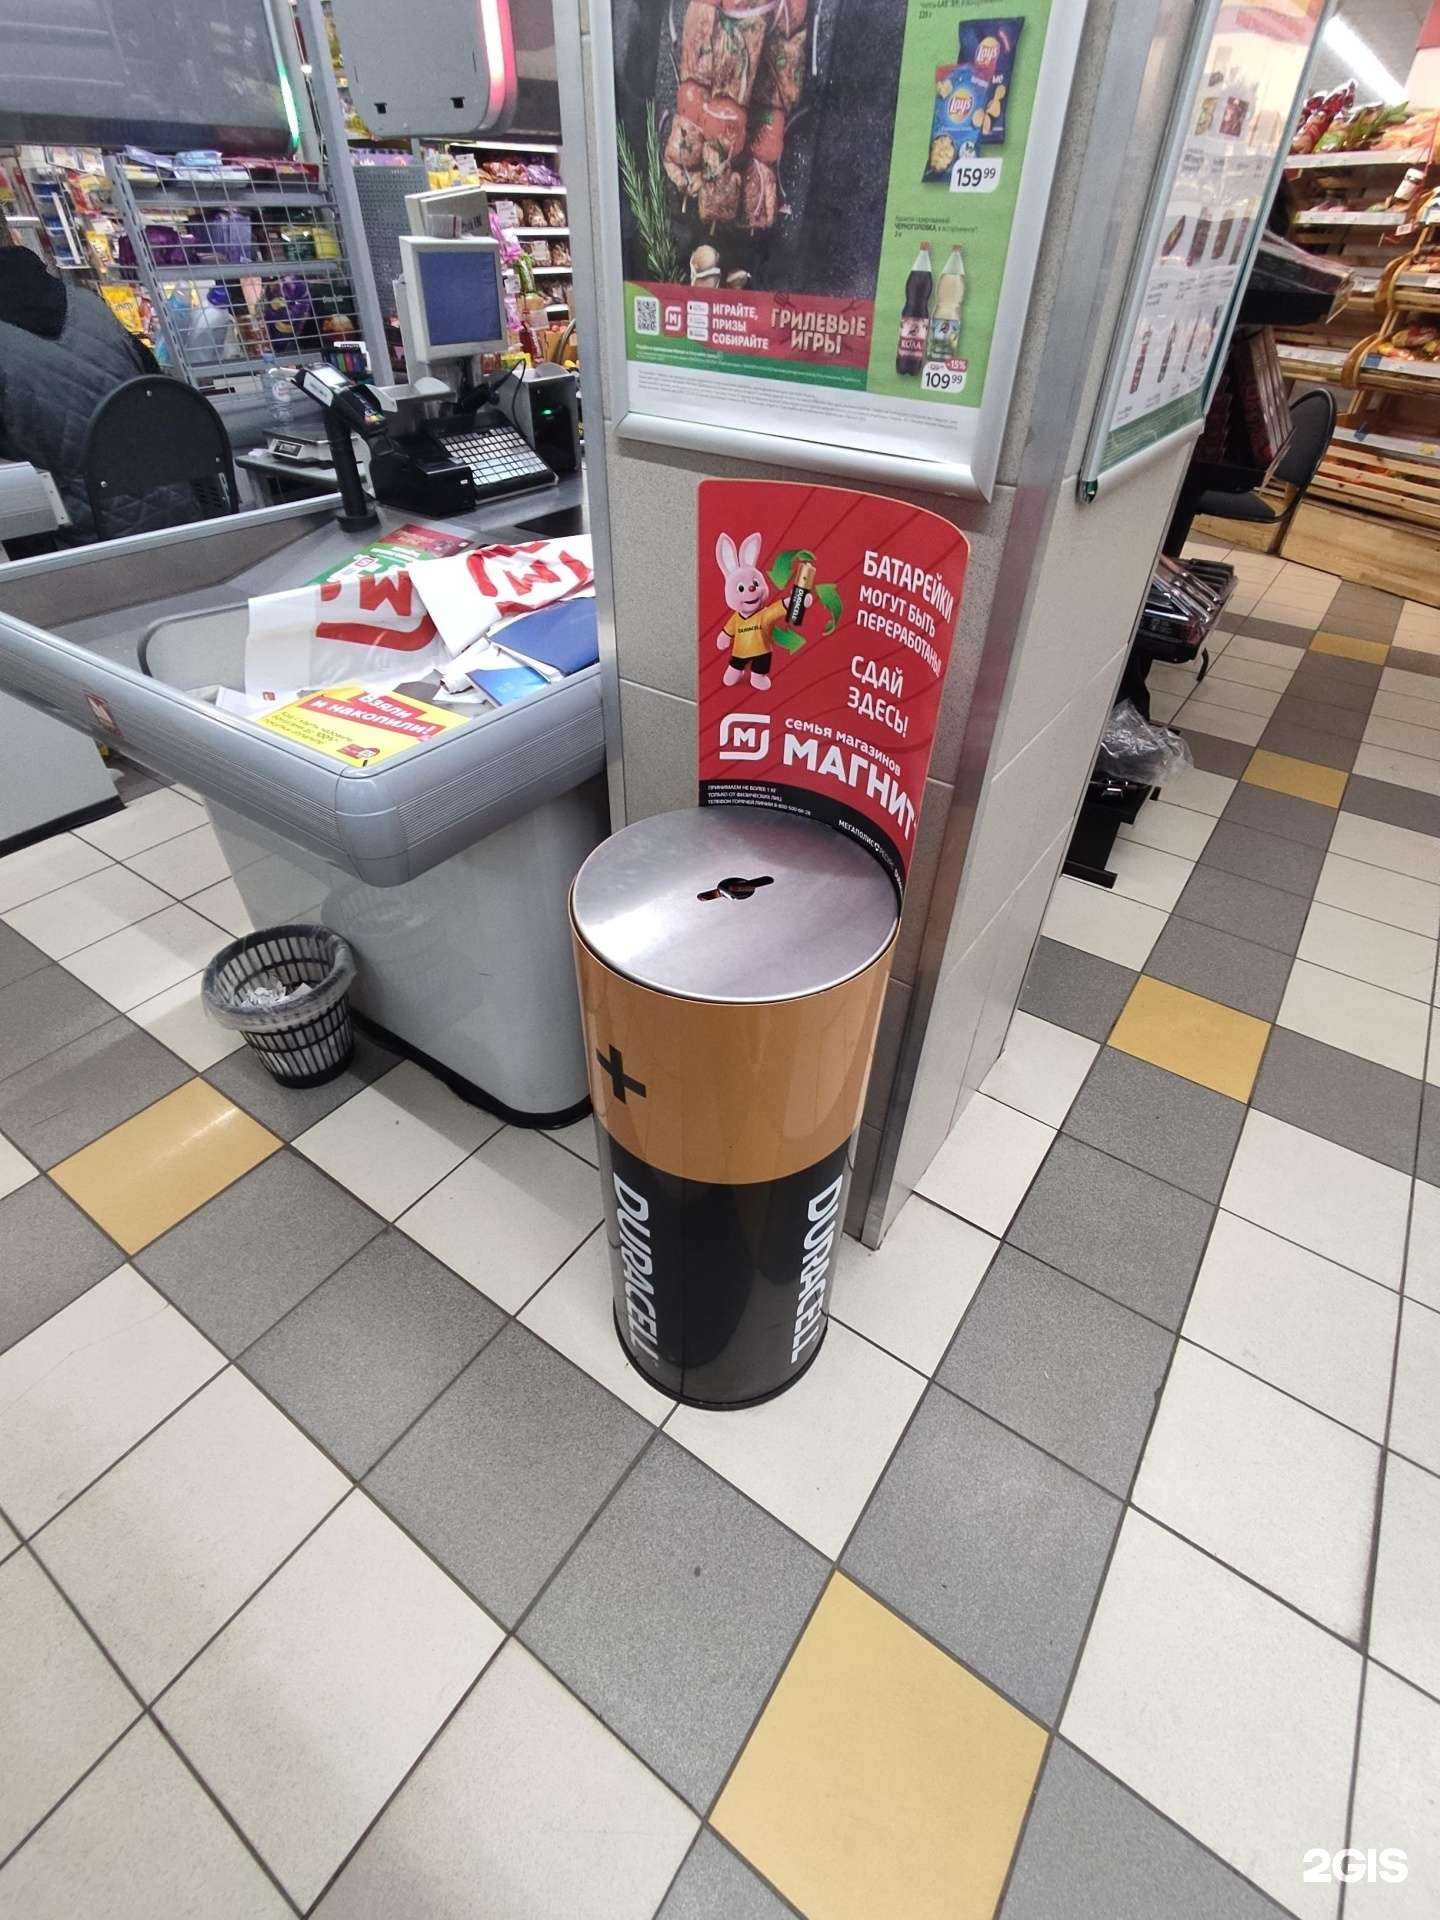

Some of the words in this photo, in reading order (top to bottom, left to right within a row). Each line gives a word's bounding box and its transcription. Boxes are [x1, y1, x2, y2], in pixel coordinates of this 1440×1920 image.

[711, 302, 759, 321] ИГРАЙТЕ,
[711, 317, 747, 332] ПРИЗЫ
[770, 308, 867, 337] ГРИЛЕВЫЕ
[711, 332, 770, 350] СОБИРАЙТЕ
[790, 329, 842, 355] ИГРЫ
[925, 371, 951, 389] 109
[863, 550, 954, 624] БАТАРЕЙКИ
[859, 584, 907, 617] МОГУТ
[907, 603, 937, 639] БЫТЬ
[851, 655, 904, 699] СДАЙ
[310, 699, 325, 709] и
[327, 704, 437, 735] накопили!
[847, 686, 909, 739] ЗДЕСЬ!
[785, 718, 833, 739] семья
[835, 730, 901, 777] магазинов
[783, 733, 916, 841] МАГНИТ
[612, 1172, 660, 1362] DURACELL
[790, 1173, 843, 1365] DURACELL
